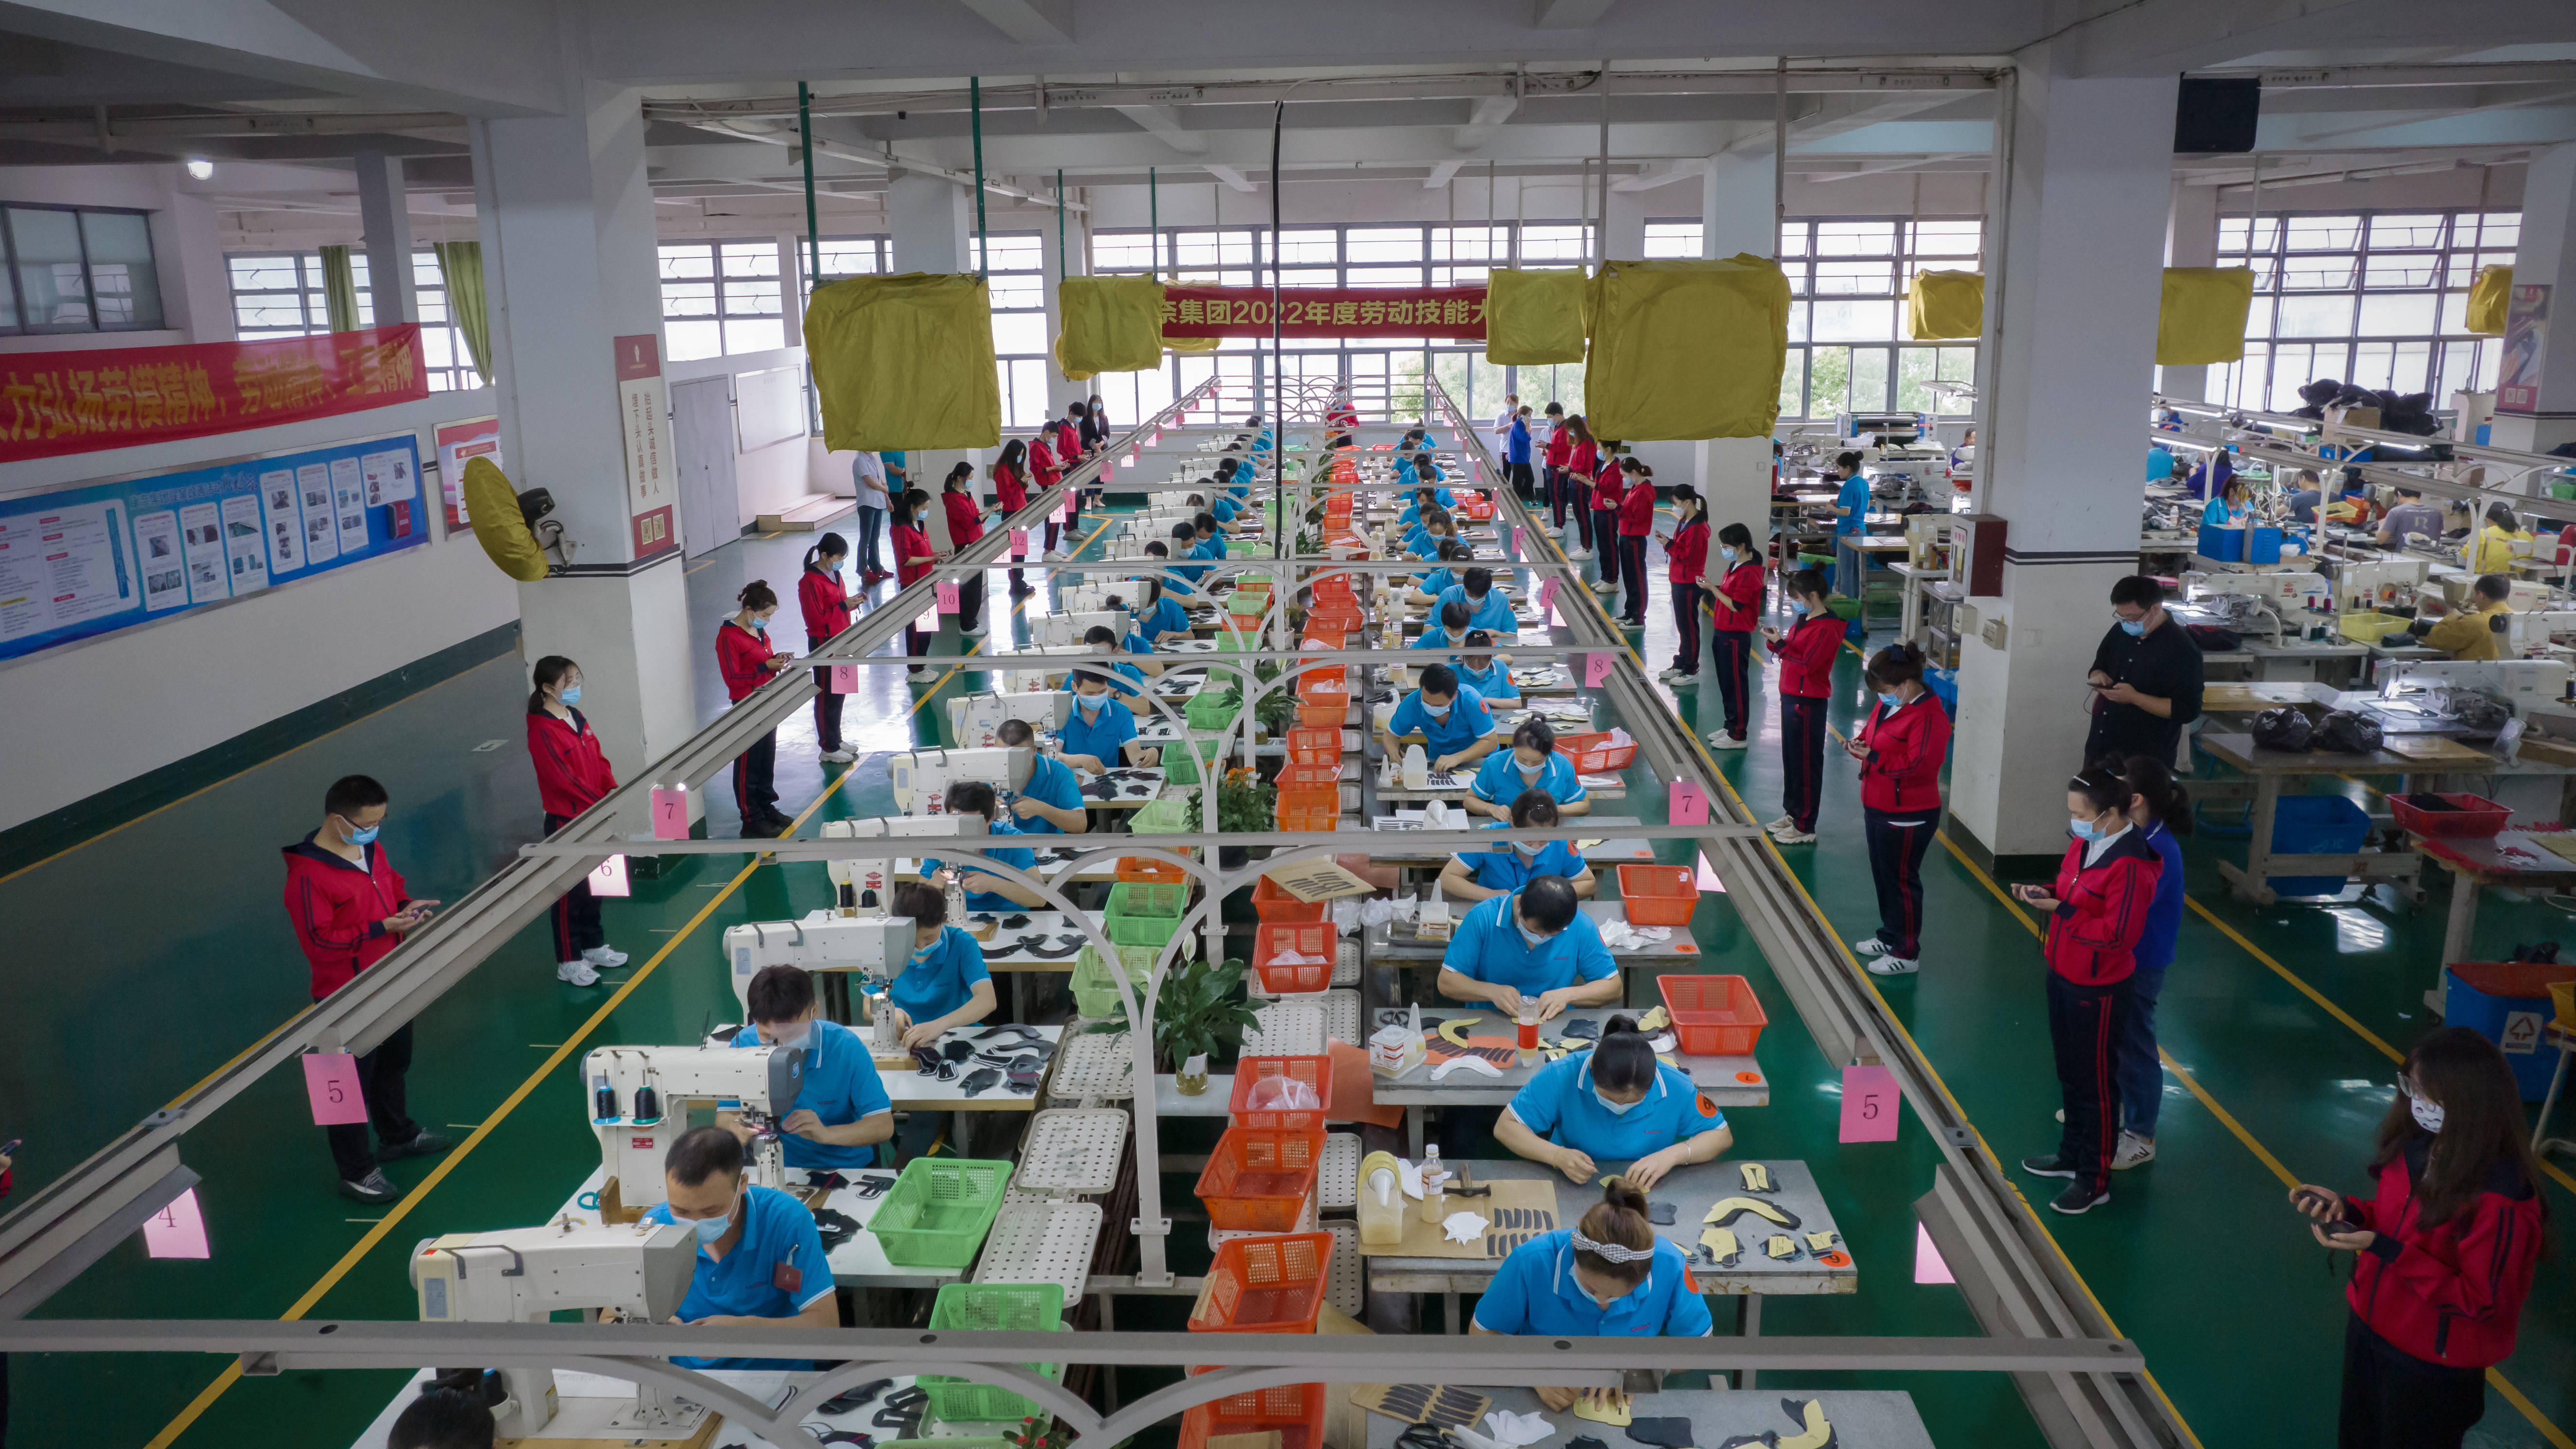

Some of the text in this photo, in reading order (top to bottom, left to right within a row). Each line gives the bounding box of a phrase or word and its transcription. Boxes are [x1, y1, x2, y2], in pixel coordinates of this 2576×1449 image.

[1012, 536, 1025, 546] 12
[942, 594, 955, 605] 10
[922, 610, 930, 620] 9
[1594, 659, 1603, 672] 8
[840, 667, 848, 680] 8
[665, 803, 675, 819] 7
[1682, 796, 1693, 813] 7
[600, 860, 612, 877] 6
[328, 1080, 343, 1103] 5
[1703, 1096, 1711, 1110] 6
[1863, 1094, 1878, 1120] 5
[158, 1205, 177, 1228] 4
